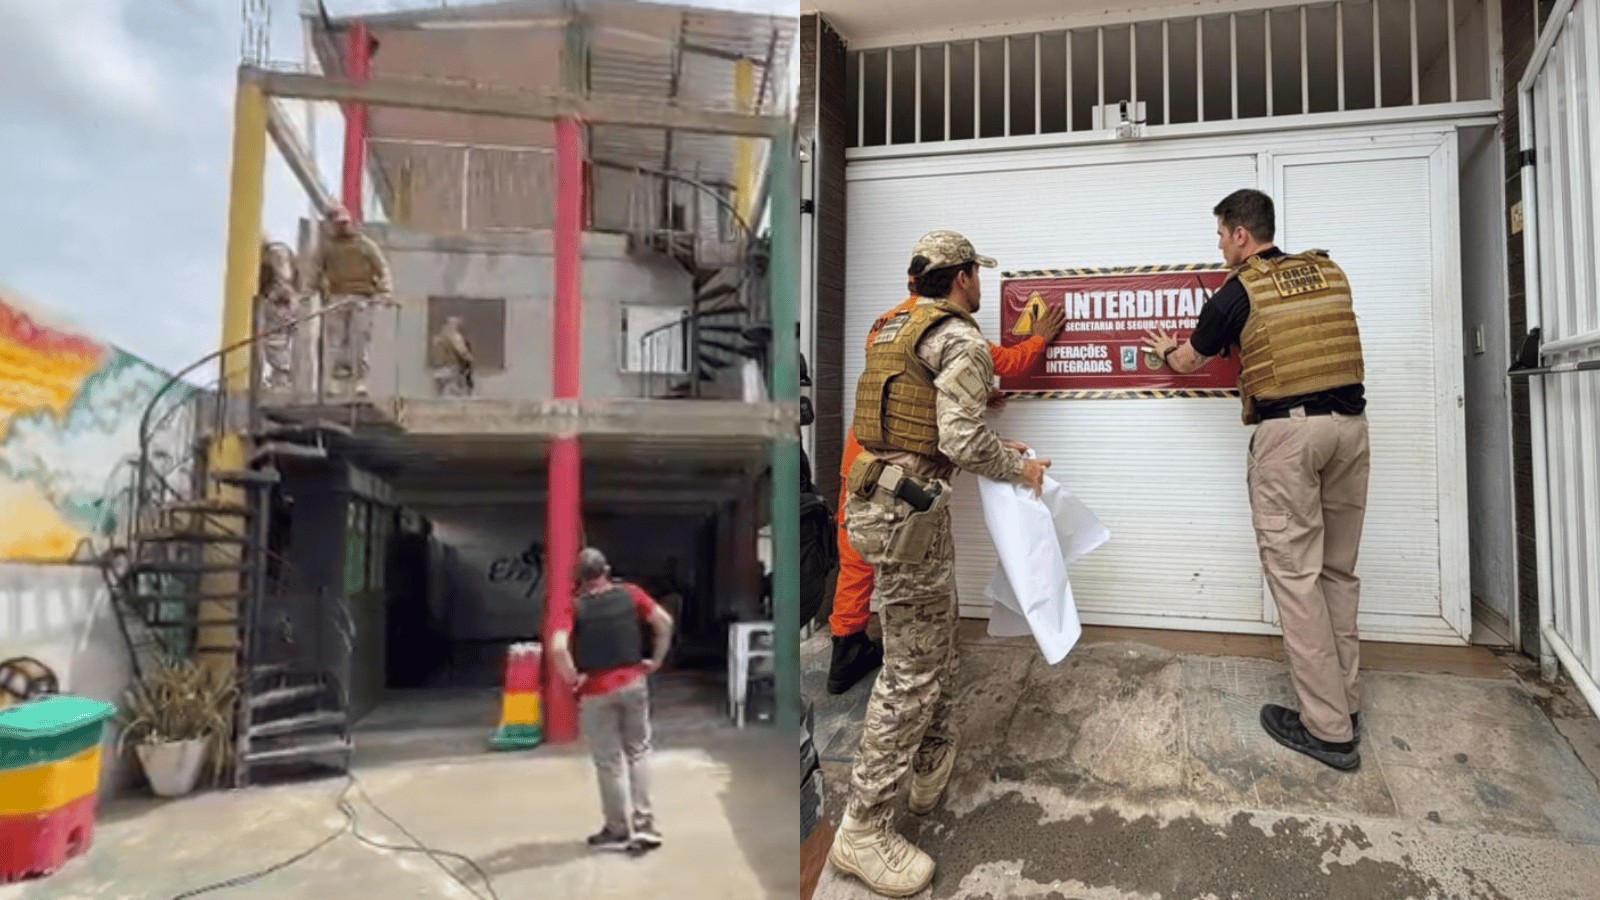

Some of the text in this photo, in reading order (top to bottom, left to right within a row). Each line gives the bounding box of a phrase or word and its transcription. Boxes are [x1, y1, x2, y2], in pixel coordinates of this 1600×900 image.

[1065, 287, 1221, 319] INTERDITAD
[1065, 320, 1114, 331] SECRETARIA
[1115, 320, 1126, 330] DE
[1046, 343, 1108, 360] OPERAÇÕES
[1046, 359, 1112, 373] INTEGRADAS
